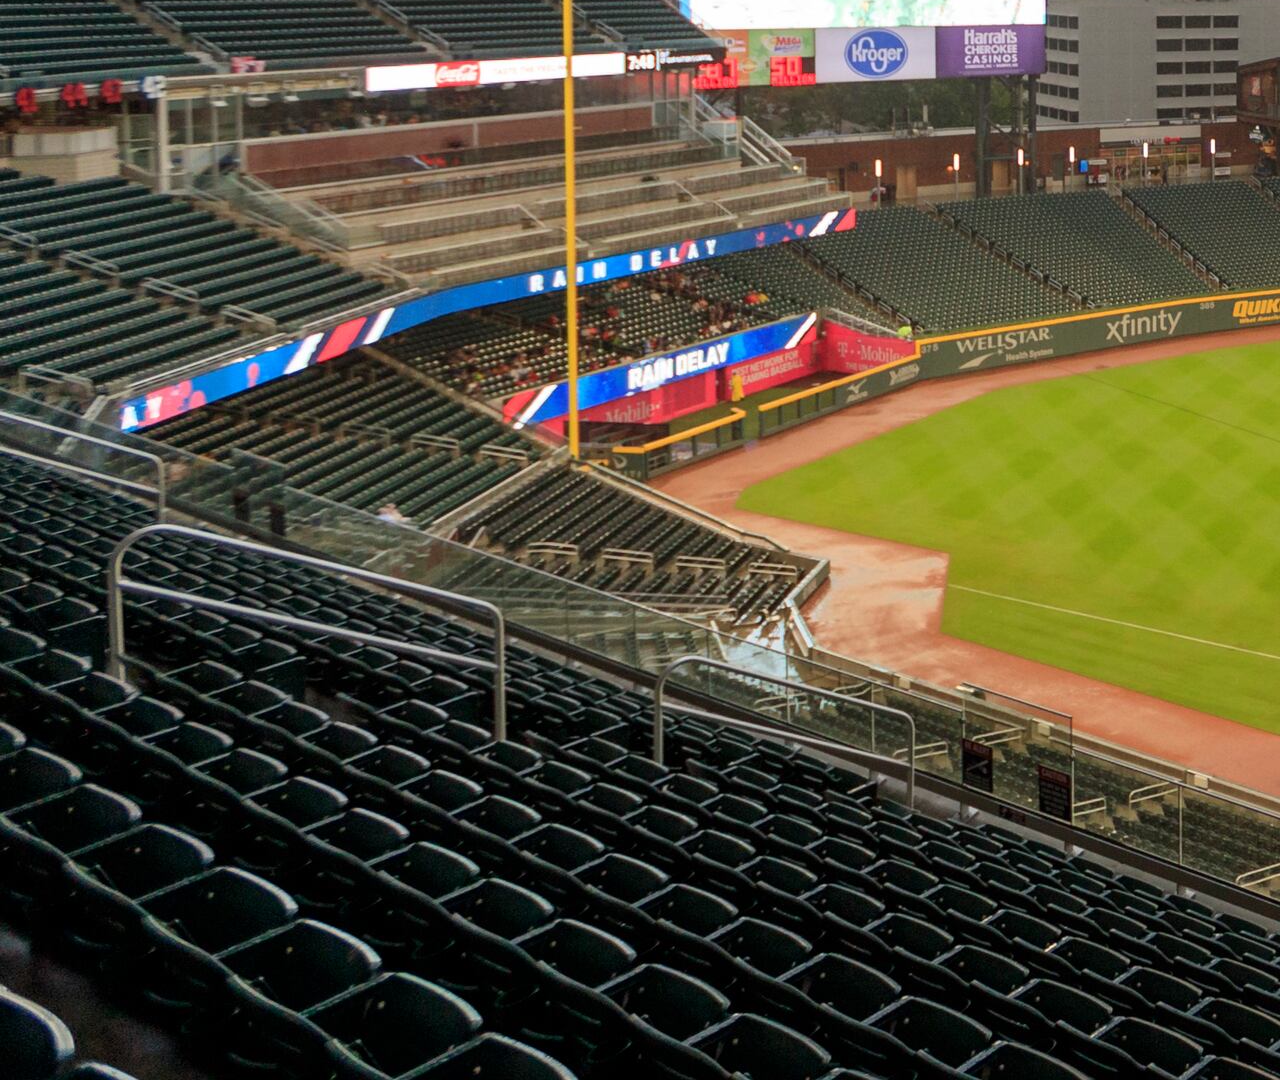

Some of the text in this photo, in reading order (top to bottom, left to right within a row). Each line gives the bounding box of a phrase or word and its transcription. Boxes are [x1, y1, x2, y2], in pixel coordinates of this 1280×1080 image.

[852, 36, 904, 73] Kroger
[964, 44, 1018, 55] CHEROKEE
[964, 54, 1018, 65] CASINOS
[434, 63, 479, 86] Coca-Cola
[629, 238, 717, 271] DELAY
[1106, 309, 1183, 344] xfinity
[956, 327, 1053, 354] WELLSTAR
[627, 341, 730, 392] RAIN DELAY
[1005, 347, 1054, 363] Health System
